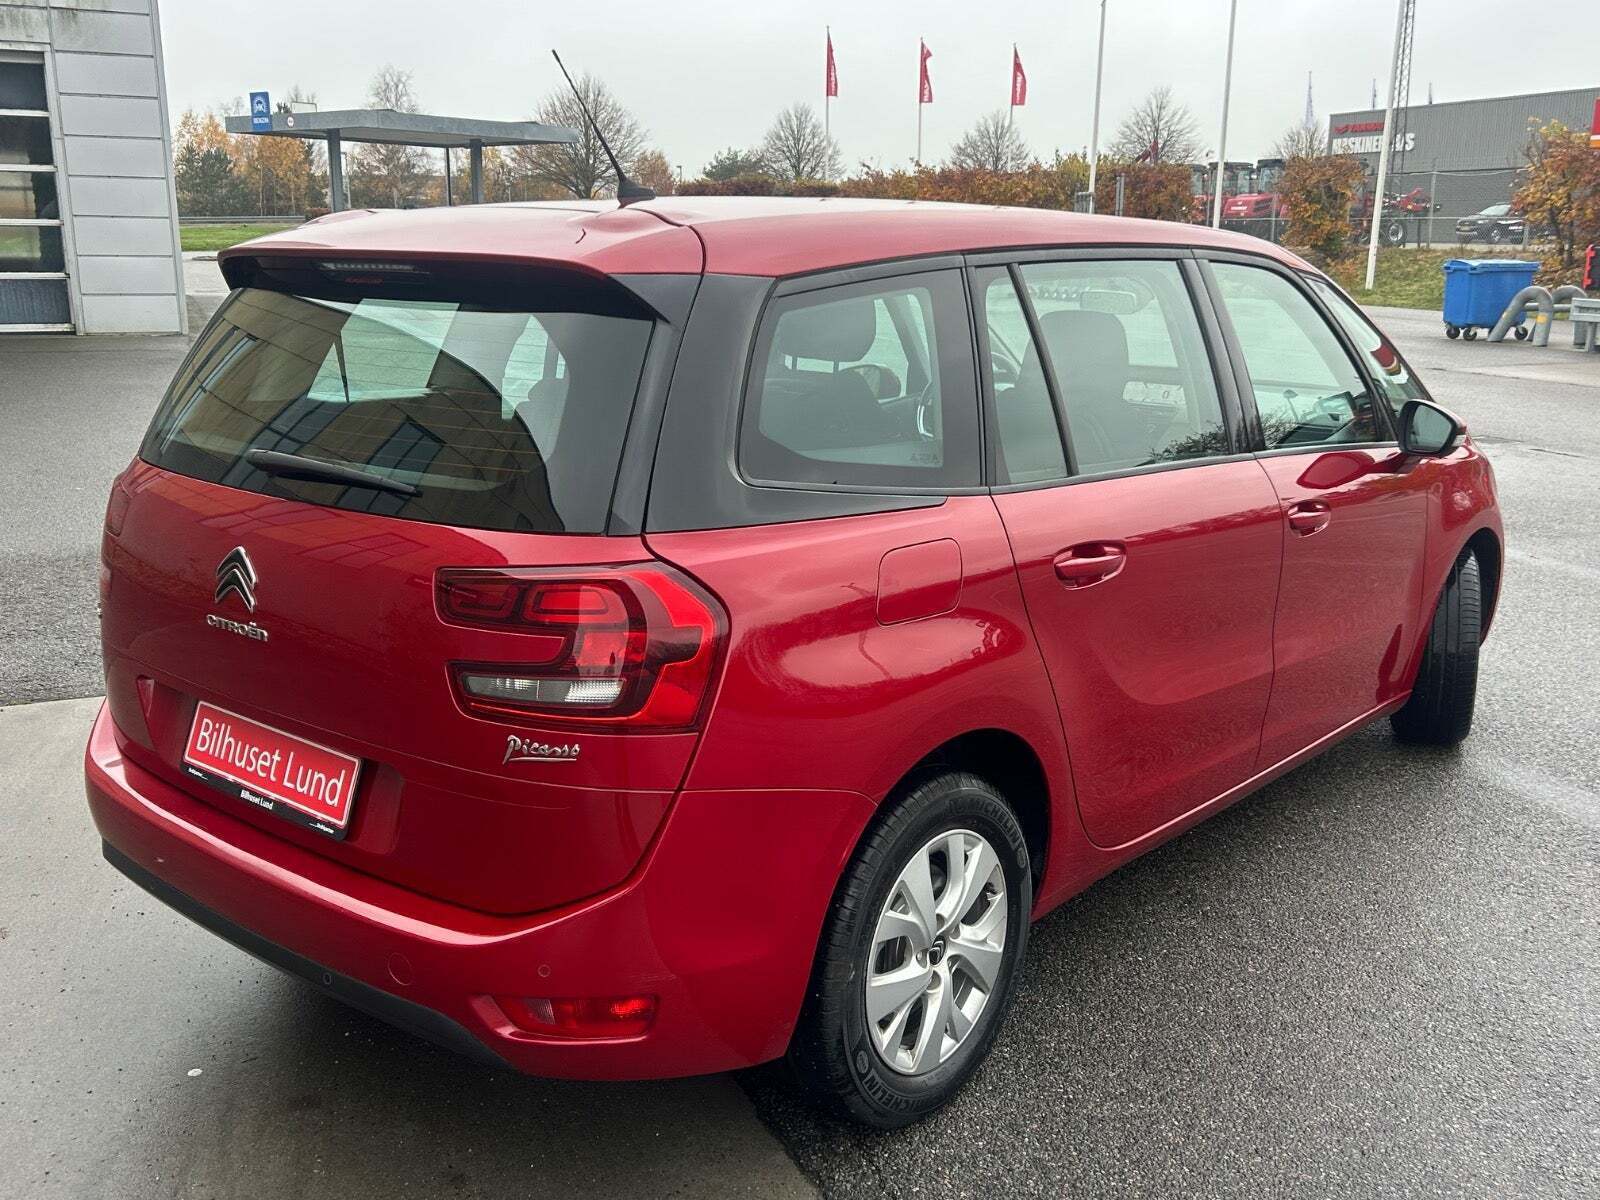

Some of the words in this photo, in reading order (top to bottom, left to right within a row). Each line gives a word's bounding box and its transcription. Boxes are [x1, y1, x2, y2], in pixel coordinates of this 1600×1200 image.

[1332, 134, 1384, 155] MASKINE
[196, 717, 282, 782] Bilhuset
[283, 751, 346, 807] Lund
[502, 734, 580, 765] Picasso
[240, 789, 261, 805] Bilhuset
[260, 797, 274, 810] Lund
